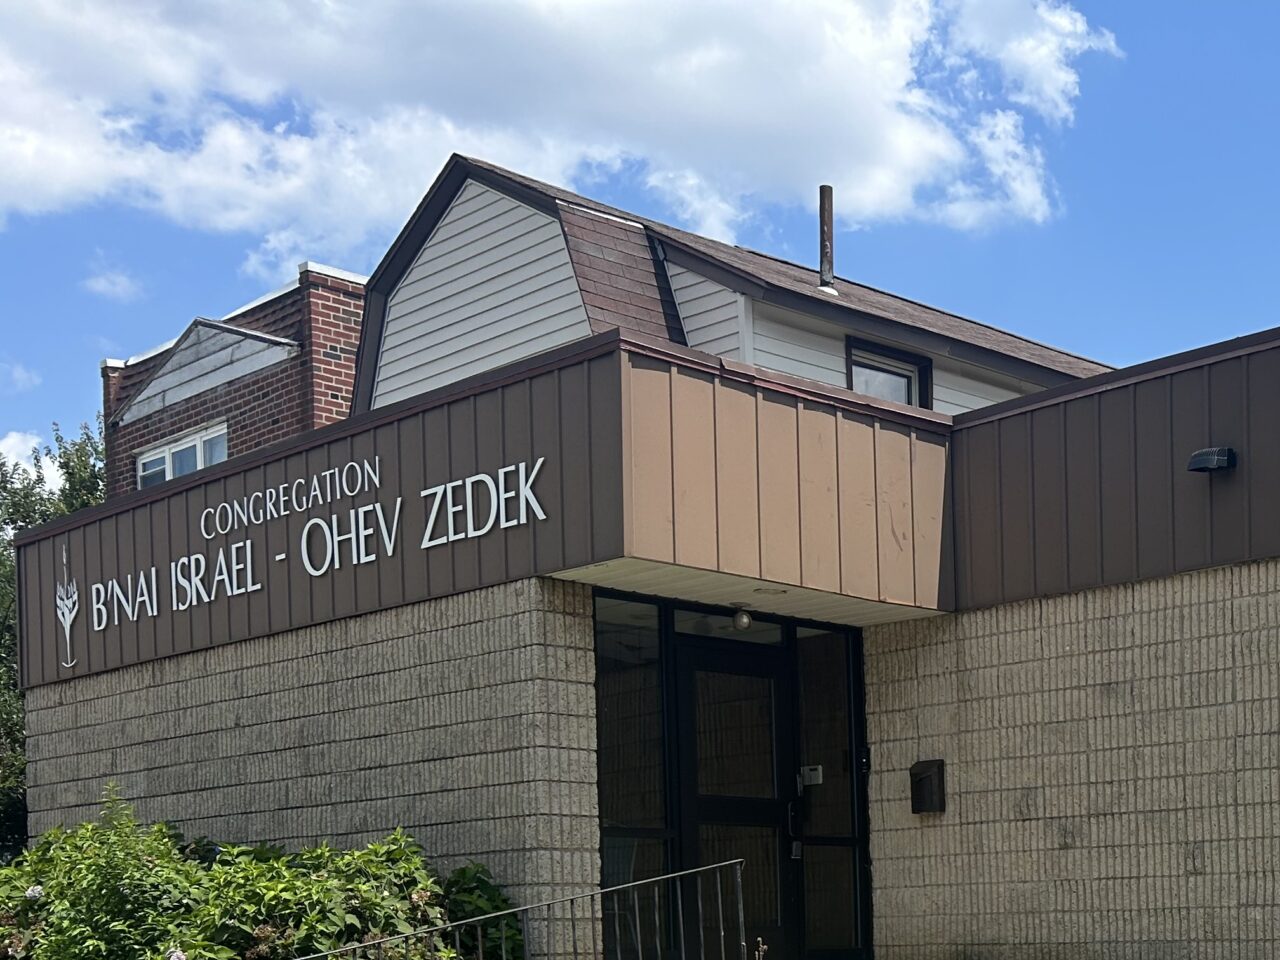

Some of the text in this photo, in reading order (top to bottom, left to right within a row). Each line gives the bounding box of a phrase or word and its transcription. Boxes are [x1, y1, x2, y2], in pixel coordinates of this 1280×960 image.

[91, 566, 158, 631] B'NAI
[171, 539, 262, 611] ISRAEL
[301, 497, 402, 577] OHEV
[420, 457, 547, 549] ZEDEK
[200, 455, 380, 540] CONGREGATION
